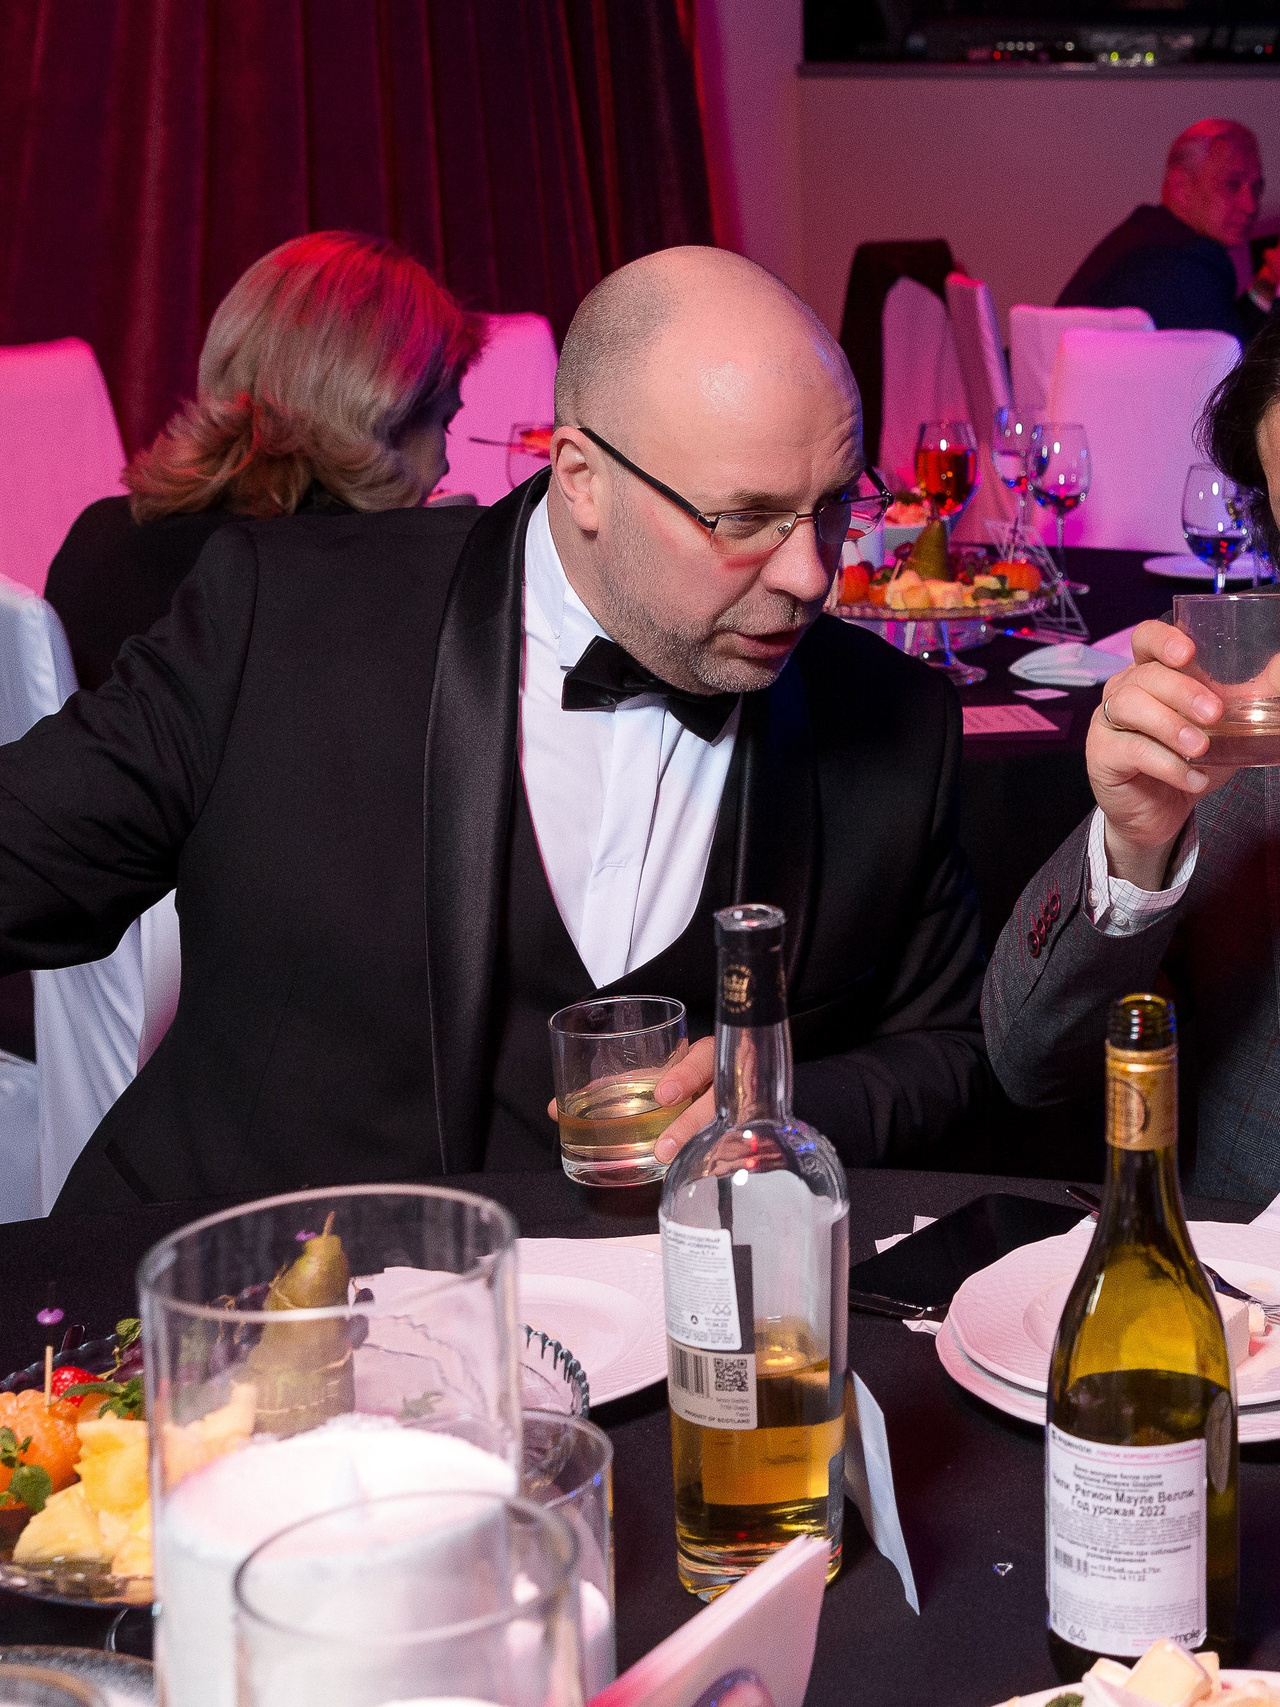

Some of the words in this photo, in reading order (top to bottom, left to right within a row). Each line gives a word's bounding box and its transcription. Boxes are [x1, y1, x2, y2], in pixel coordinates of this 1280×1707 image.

[1075, 1483, 1112, 1502] Регион
[1115, 1491, 1154, 1506] Мауле
[1071, 1495, 1090, 1512] Год
[1092, 1503, 1136, 1516] урожая
[1139, 1505, 1167, 1517] 2022
